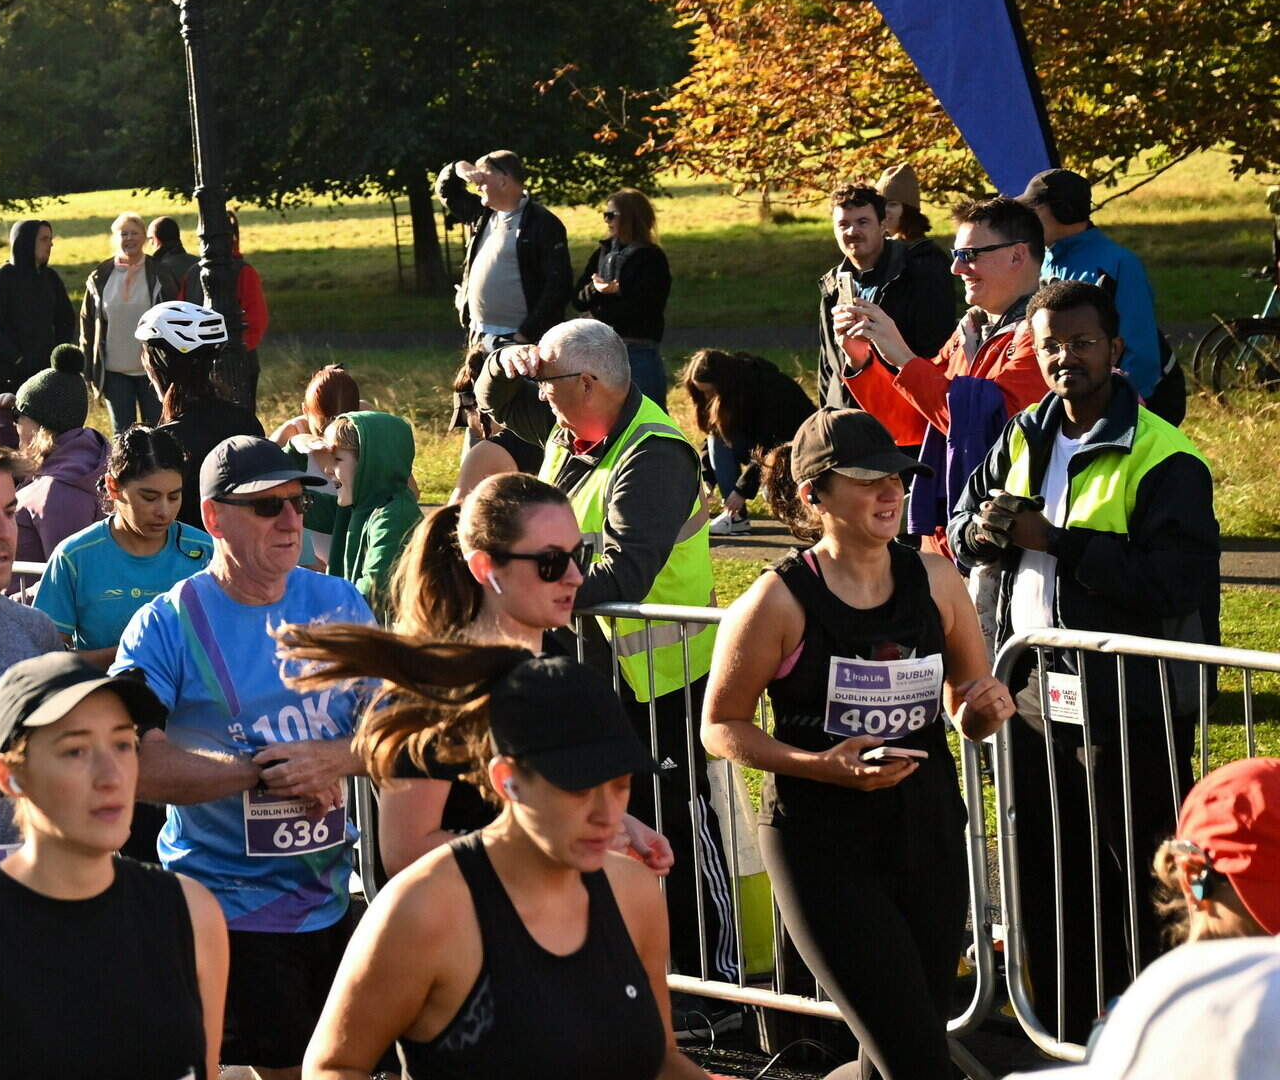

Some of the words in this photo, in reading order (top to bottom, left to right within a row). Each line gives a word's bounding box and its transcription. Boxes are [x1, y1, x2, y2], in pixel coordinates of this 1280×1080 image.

[853, 672, 870, 682] Irish
[870, 674, 885, 682] Life
[896, 669, 934, 680] DUBLIN
[835, 692, 868, 702] DUBLIN
[870, 695, 891, 703] HALF
[893, 689, 936, 701] MARATHON
[252, 690, 340, 744] 10K
[840, 705, 927, 734] 4098
[250, 807, 282, 817] DUBLIN
[283, 806, 305, 815] HALF
[273, 817, 329, 848] 636
